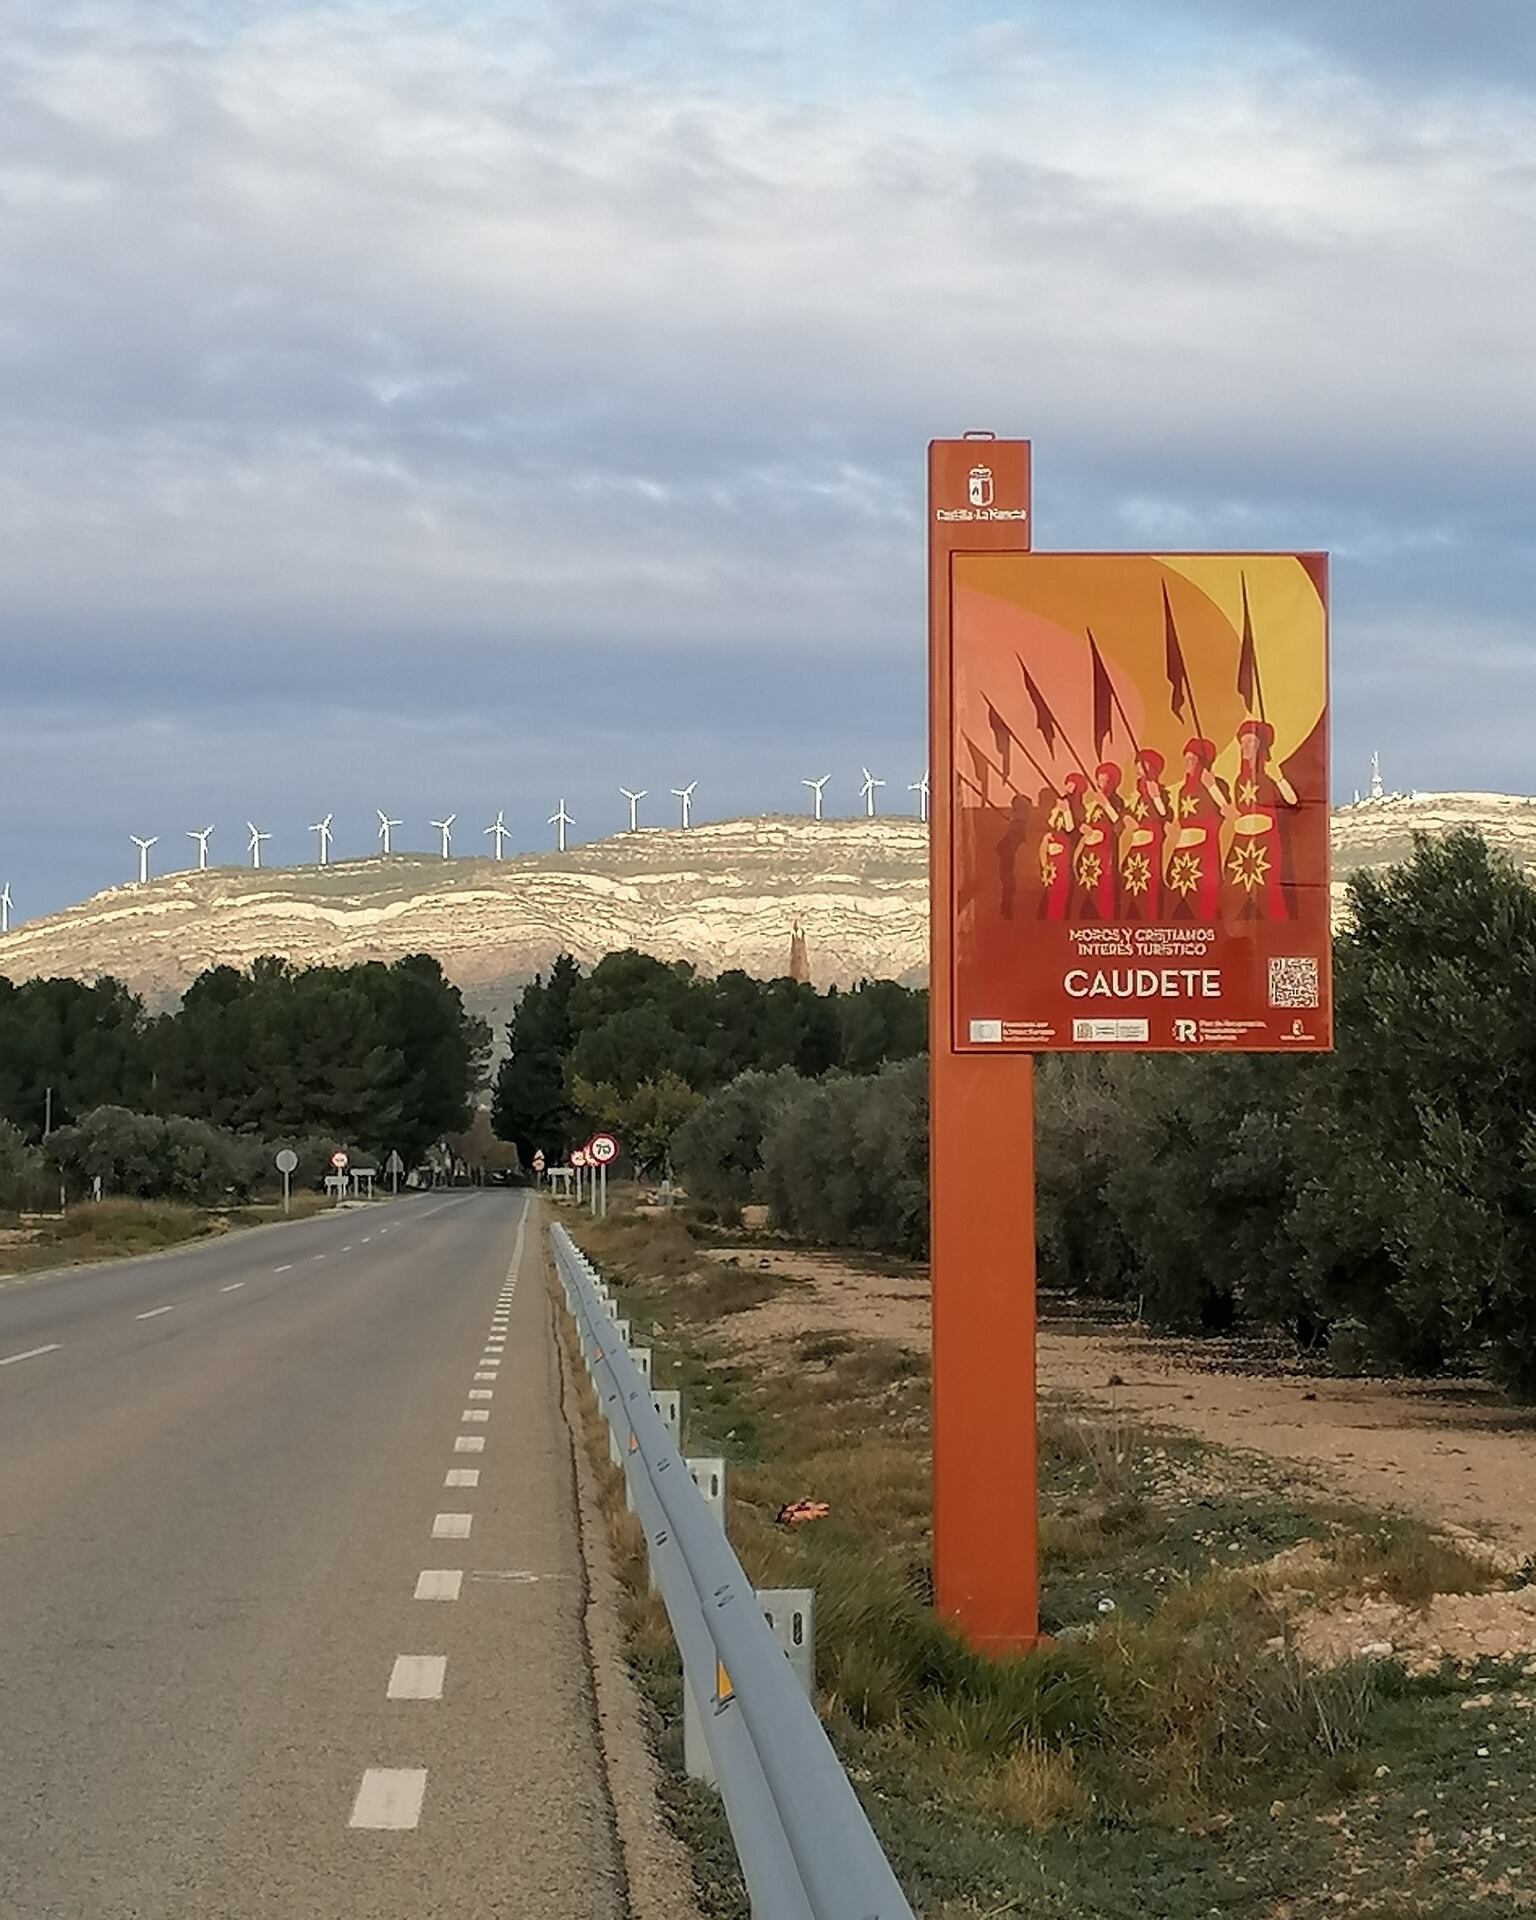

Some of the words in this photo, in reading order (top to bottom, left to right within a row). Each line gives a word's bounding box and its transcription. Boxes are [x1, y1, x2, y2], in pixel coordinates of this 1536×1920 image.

[1121, 929, 1132, 941] Y
[1063, 968, 1222, 998] CAUDETE
[595, 1143, 612, 1155] 70
